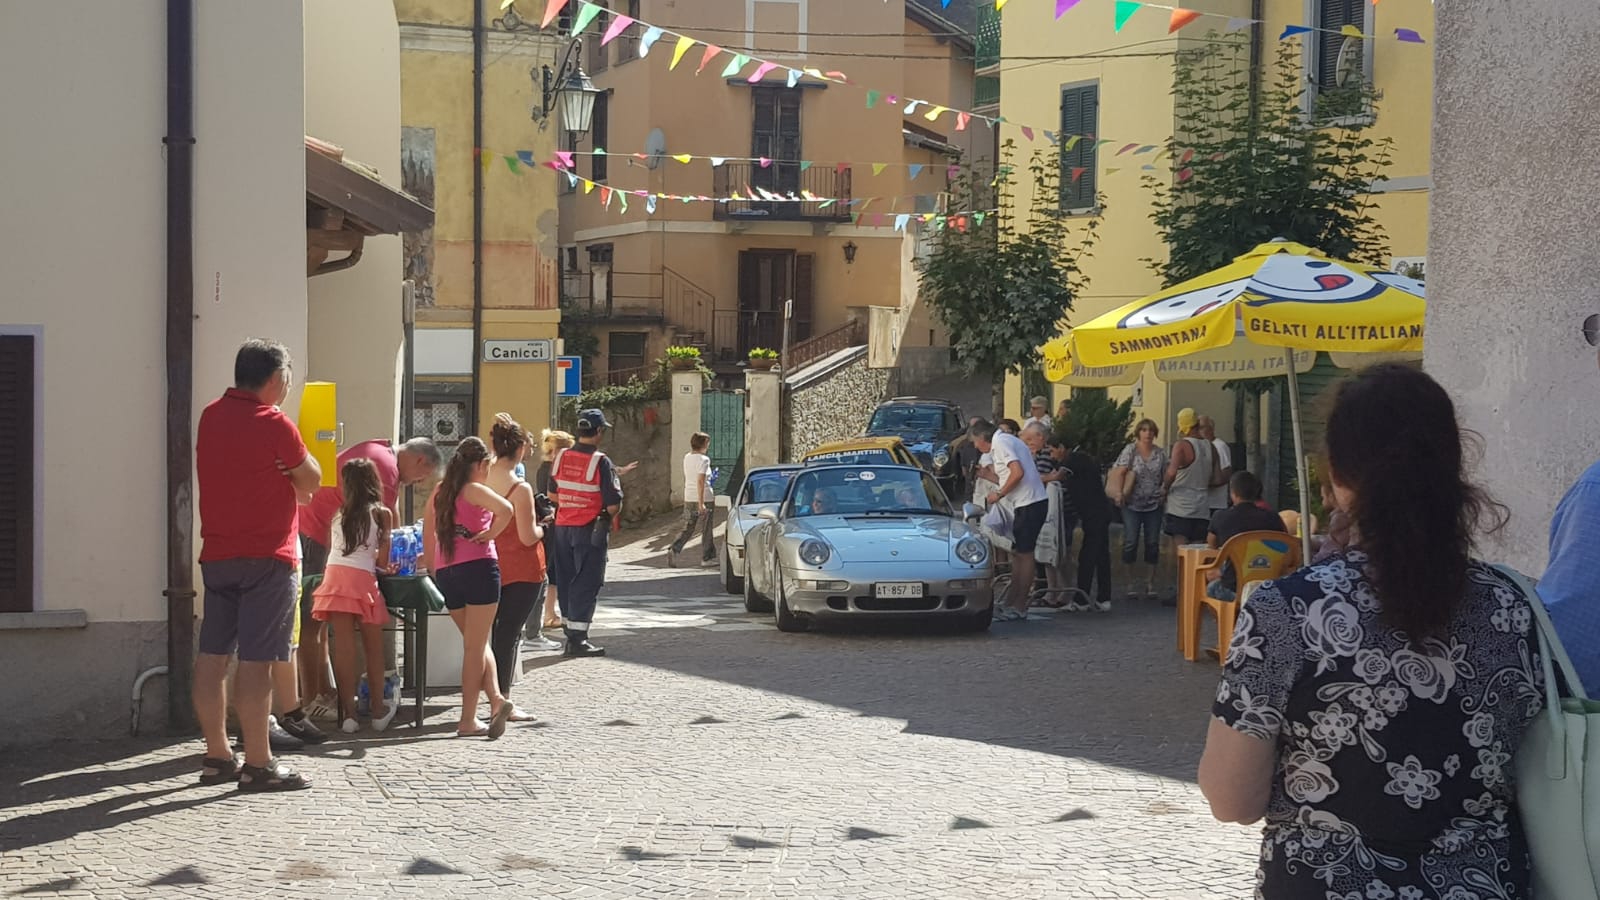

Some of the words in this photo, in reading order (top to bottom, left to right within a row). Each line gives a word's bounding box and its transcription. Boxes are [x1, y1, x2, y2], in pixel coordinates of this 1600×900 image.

[1109, 325, 1207, 355] SAMMONTANA
[1251, 318, 1307, 338] GELATI
[1315, 325, 1424, 340] ALL'ITALIAN
[492, 347, 543, 358] Canicci
